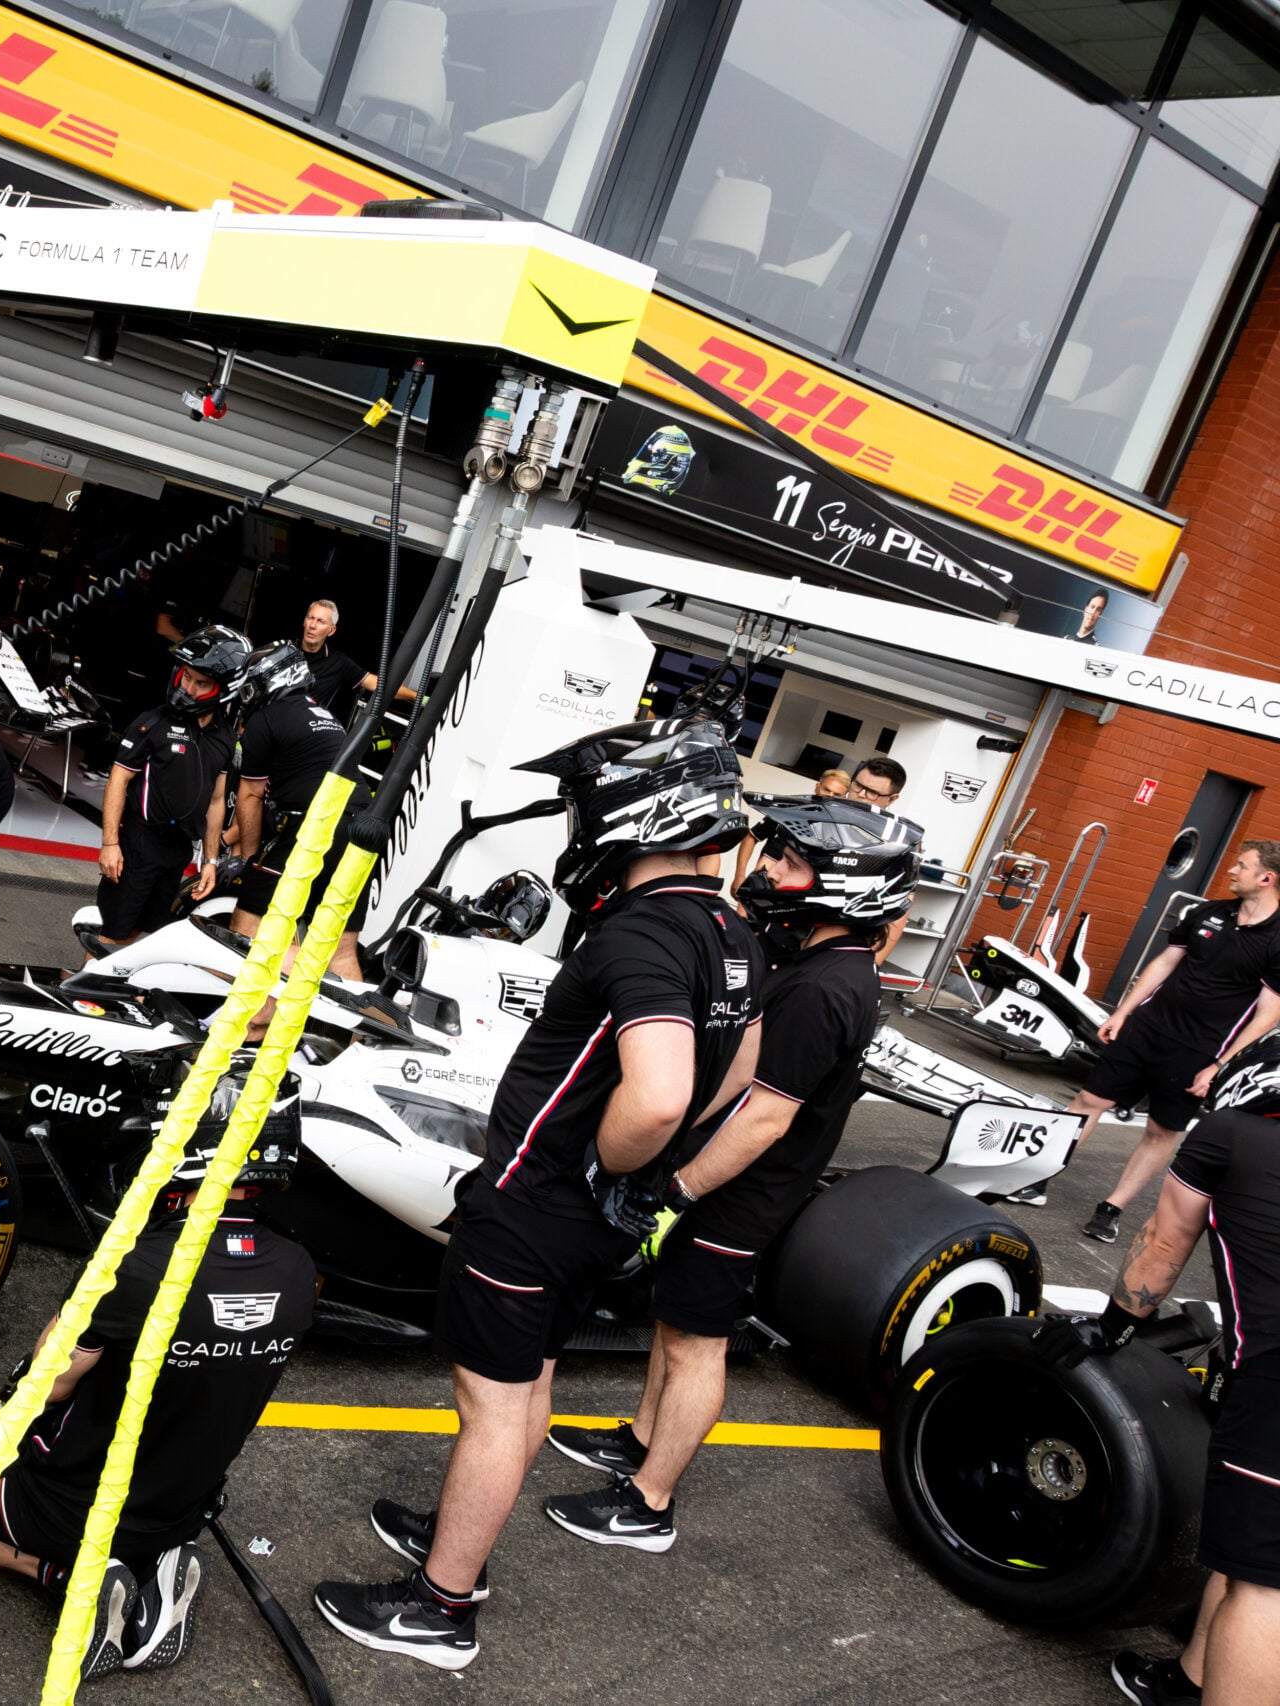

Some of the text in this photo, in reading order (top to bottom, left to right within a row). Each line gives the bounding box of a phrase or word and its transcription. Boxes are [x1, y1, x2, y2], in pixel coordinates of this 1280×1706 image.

[18, 241, 104, 263] FORMULA
[113, 248, 121, 264] 1
[130, 248, 189, 271] TEAM
[690, 336, 869, 460] DHL
[773, 475, 811, 528] 11
[813, 502, 877, 567] Sergio
[973, 463, 1122, 561] DHL
[538, 693, 616, 720] CADILLAC
[1127, 670, 1280, 719] CADILLAC
[1017, 980, 1038, 995] FIA
[1000, 1003, 1045, 1034] 3M
[425, 1069, 457, 1081] CORE
[31, 1084, 108, 1118] Claro
[1000, 1122, 1048, 1157] IFS
[988, 1233, 1029, 1260] PIRELLI
[171, 1337, 295, 1357] CADILLAC
